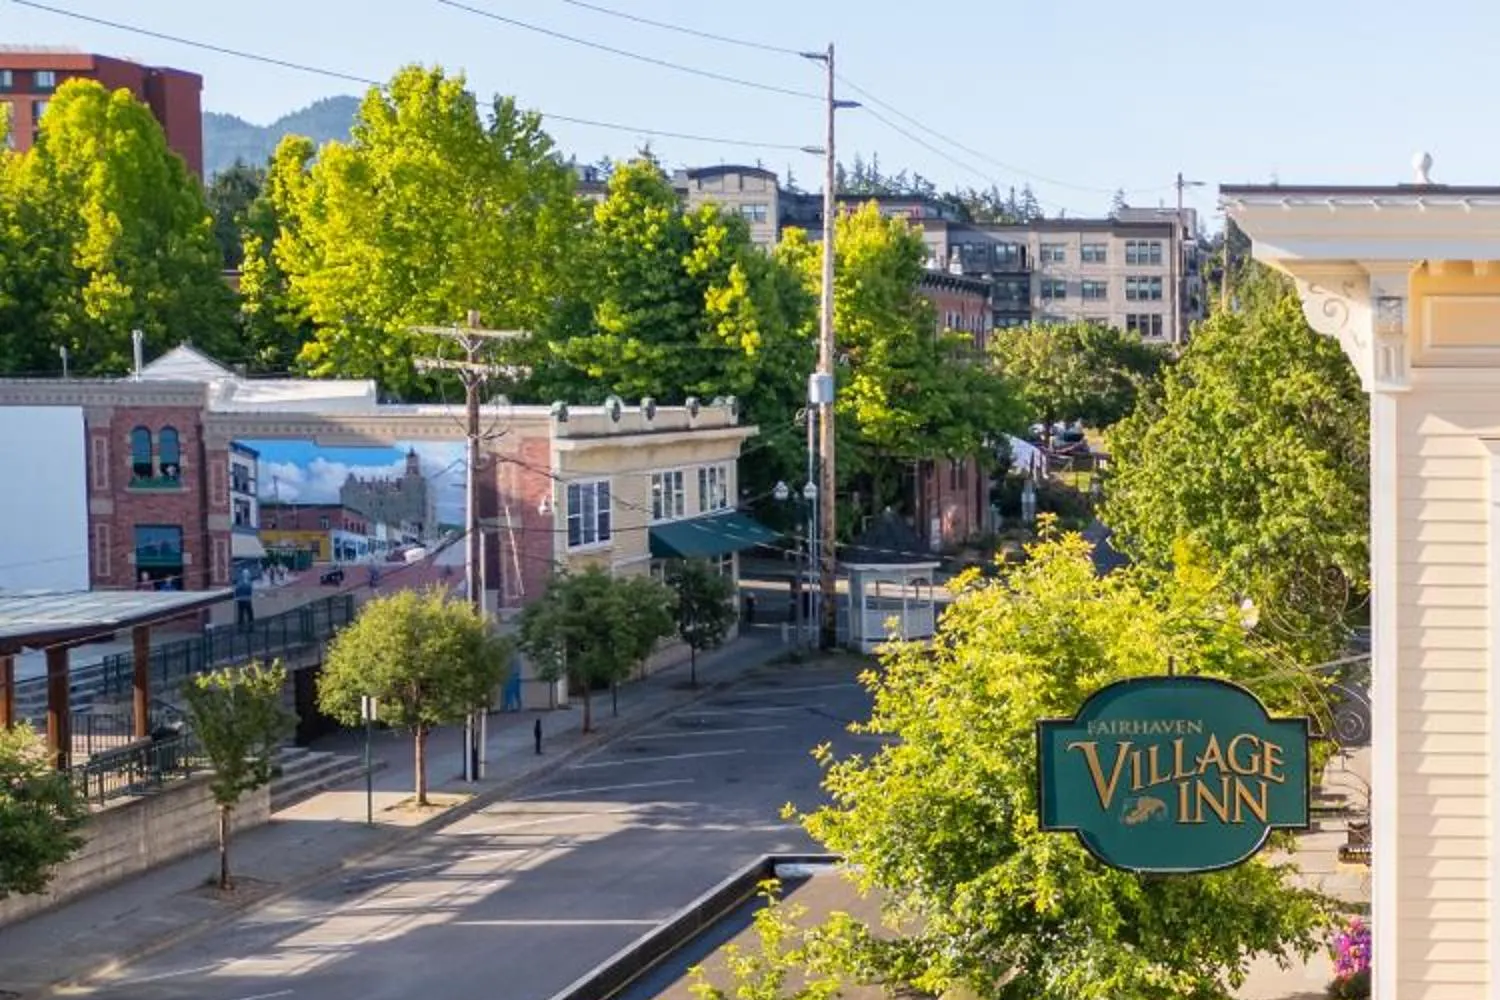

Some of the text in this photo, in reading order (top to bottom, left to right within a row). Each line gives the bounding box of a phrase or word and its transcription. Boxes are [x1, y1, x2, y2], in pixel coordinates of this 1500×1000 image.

[1087, 720, 1203, 735] FAIRHAVEN
[1066, 733, 1285, 809] VILLAGE
[1176, 775, 1268, 823] INN
